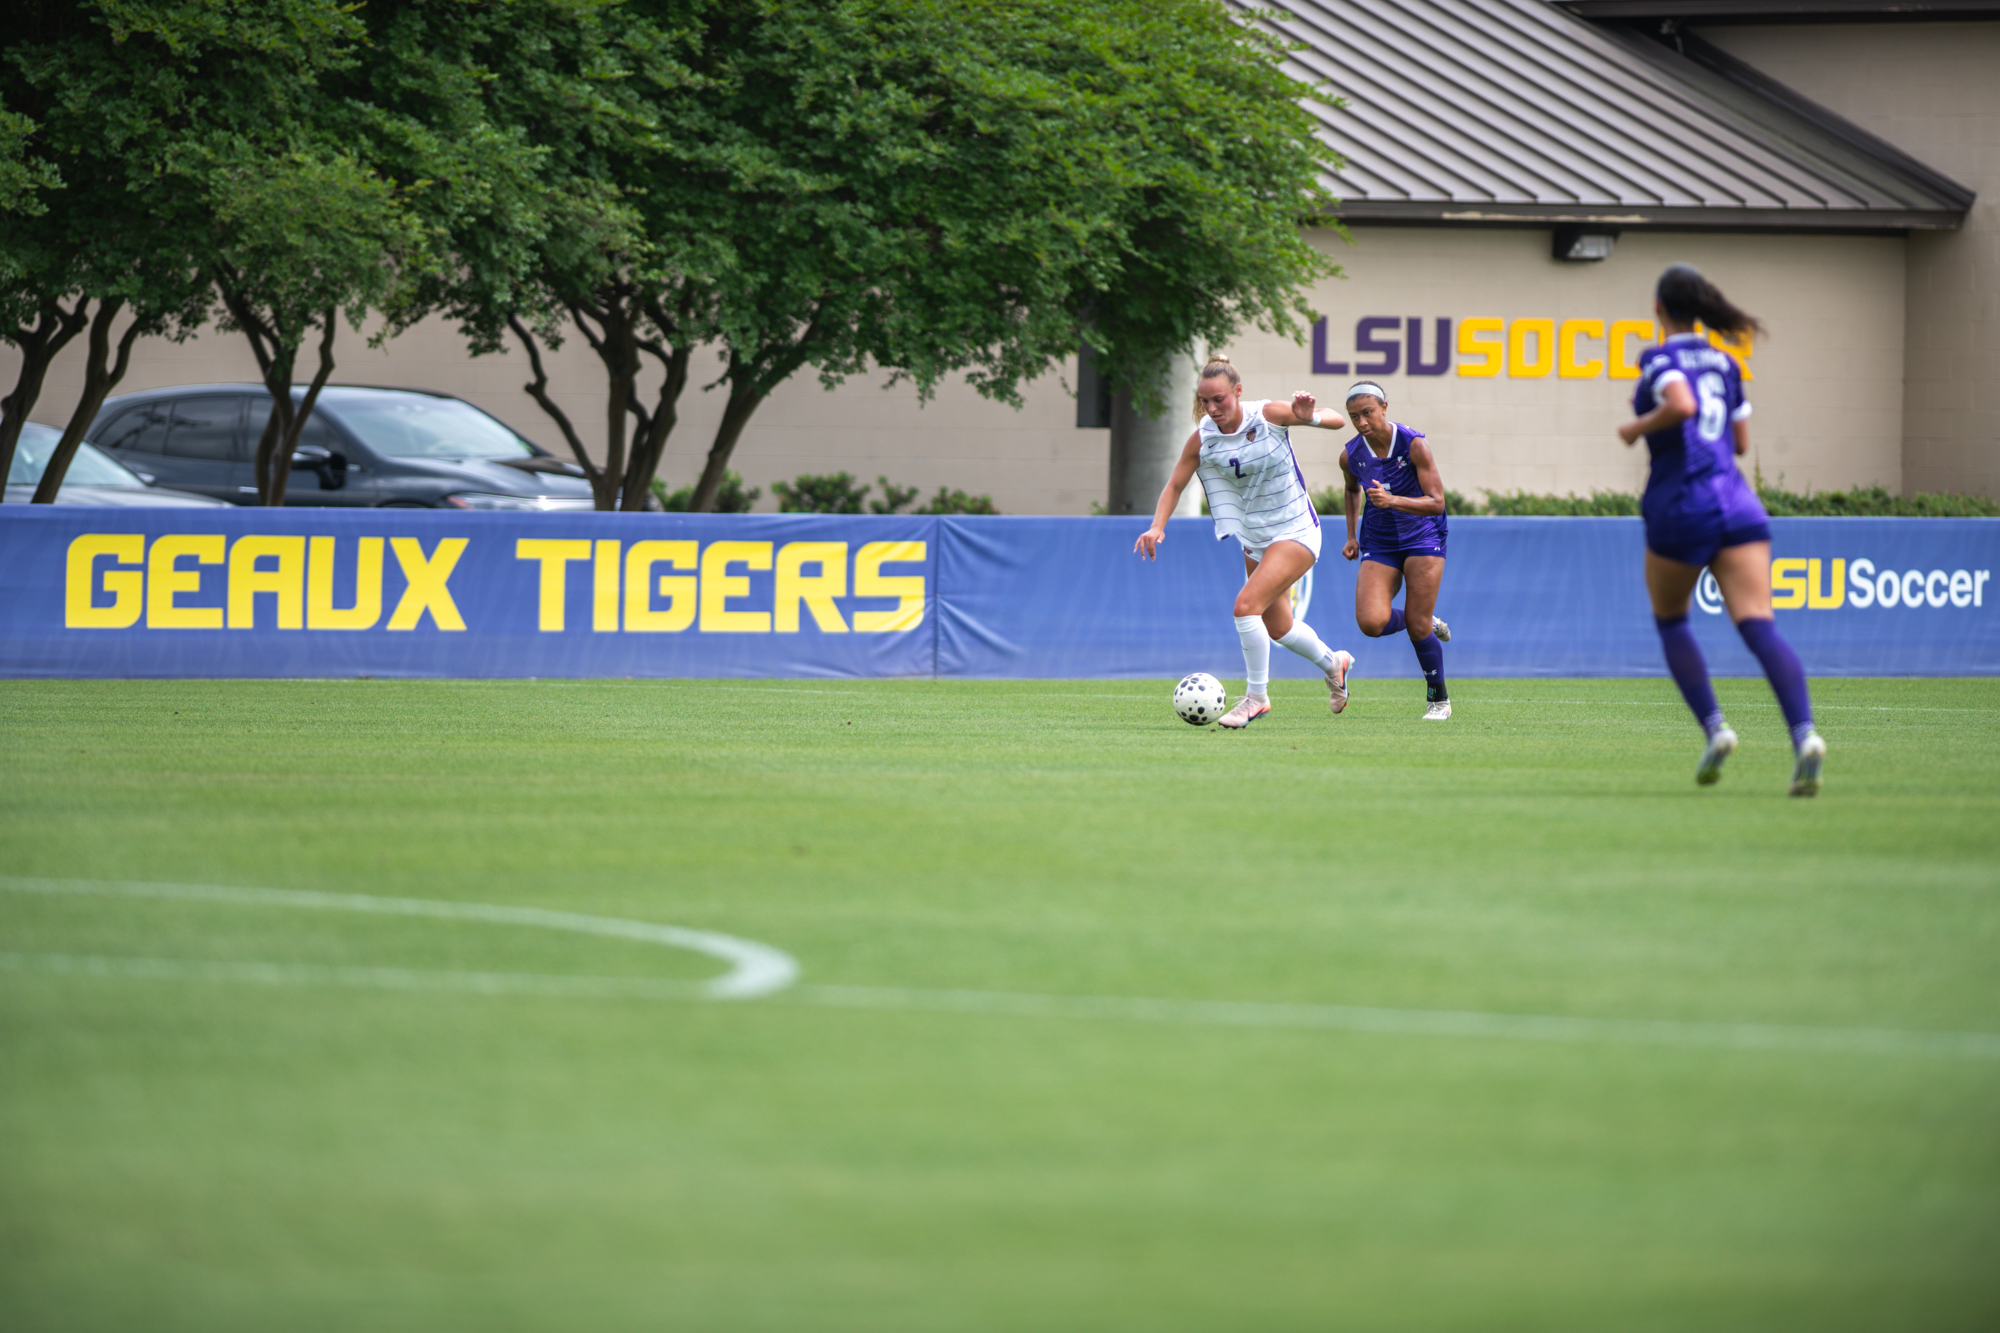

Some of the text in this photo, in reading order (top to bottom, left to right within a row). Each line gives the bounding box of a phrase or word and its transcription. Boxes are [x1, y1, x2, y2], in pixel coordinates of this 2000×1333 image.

[1696, 371, 1727, 440] 6
[1229, 457, 1247, 479] 2
[65, 533, 927, 633] GEAUX TIGERS
[1695, 557, 1990, 615] @SUSoccer
